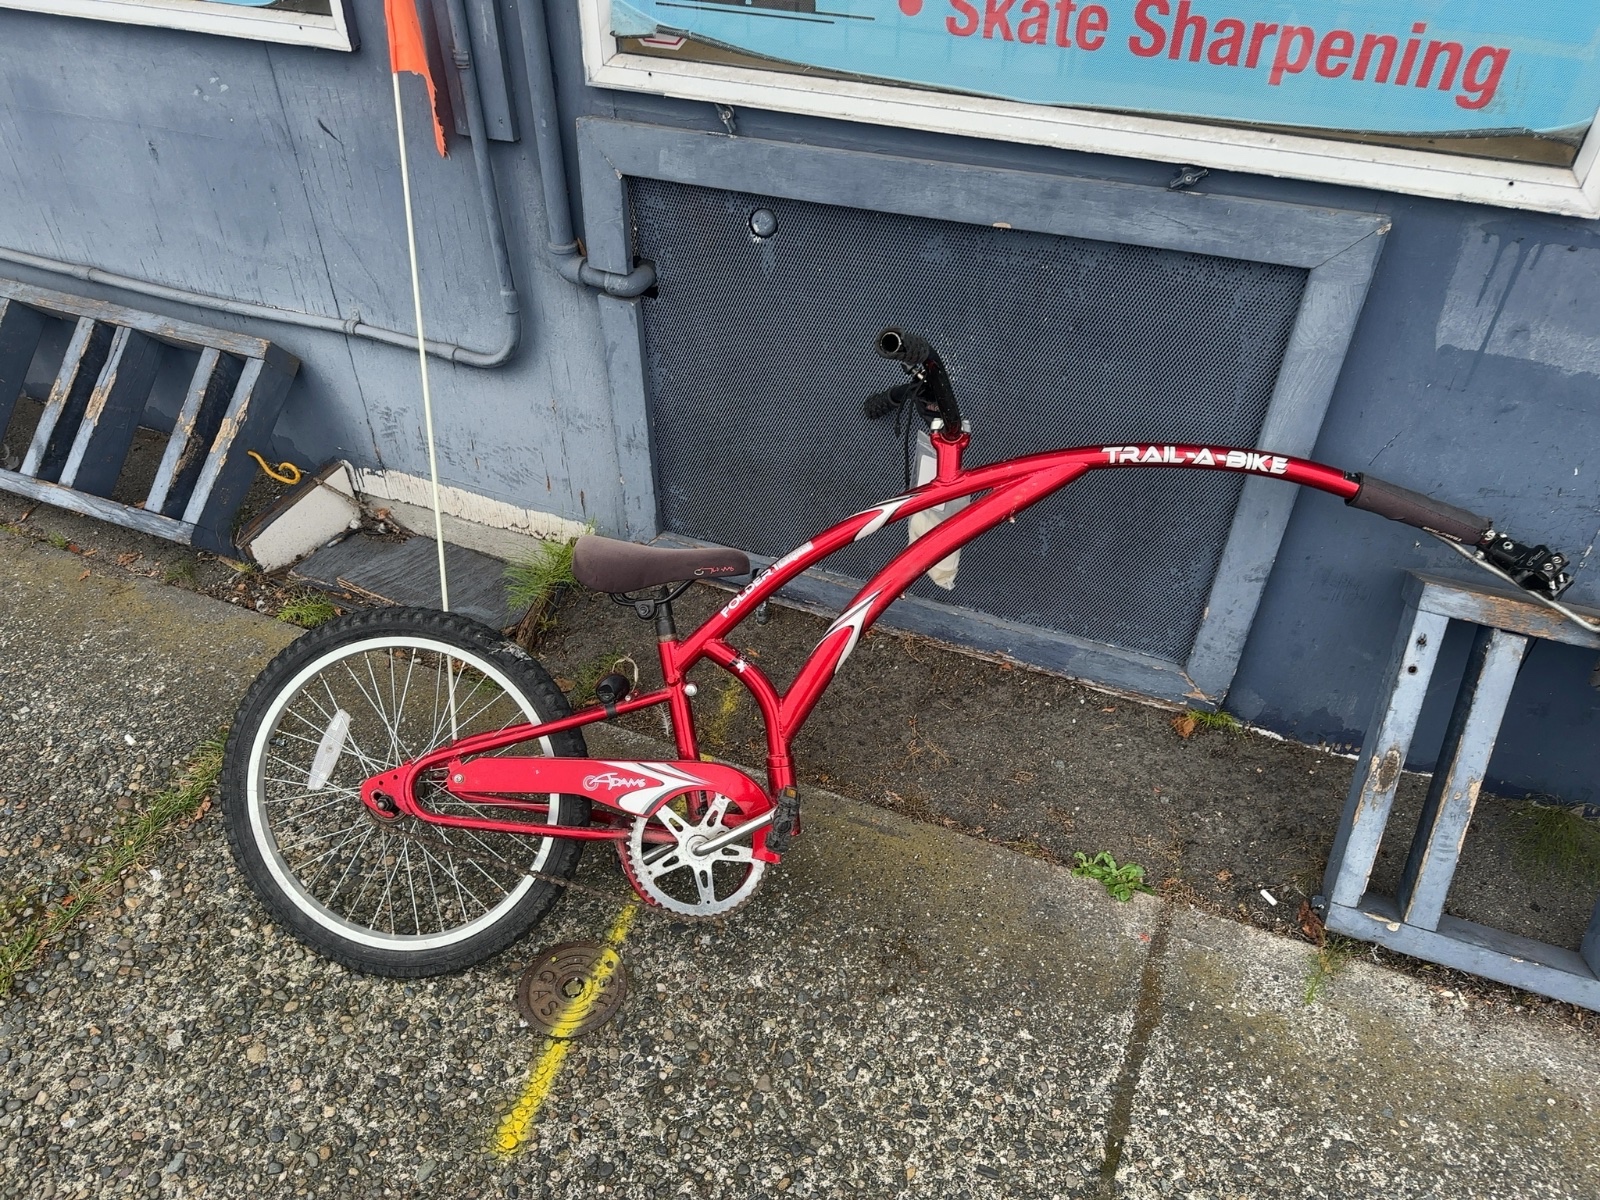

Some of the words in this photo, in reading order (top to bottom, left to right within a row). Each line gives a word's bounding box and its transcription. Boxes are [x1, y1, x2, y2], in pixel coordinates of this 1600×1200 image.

[945, 0, 1108, 51] Skate
[1128, 0, 1511, 110] Sharpening
[1101, 446, 1288, 475] TRAIL-A-BIKE
[720, 568, 774, 619] FOLDER
[533, 970, 559, 1017] GAS
